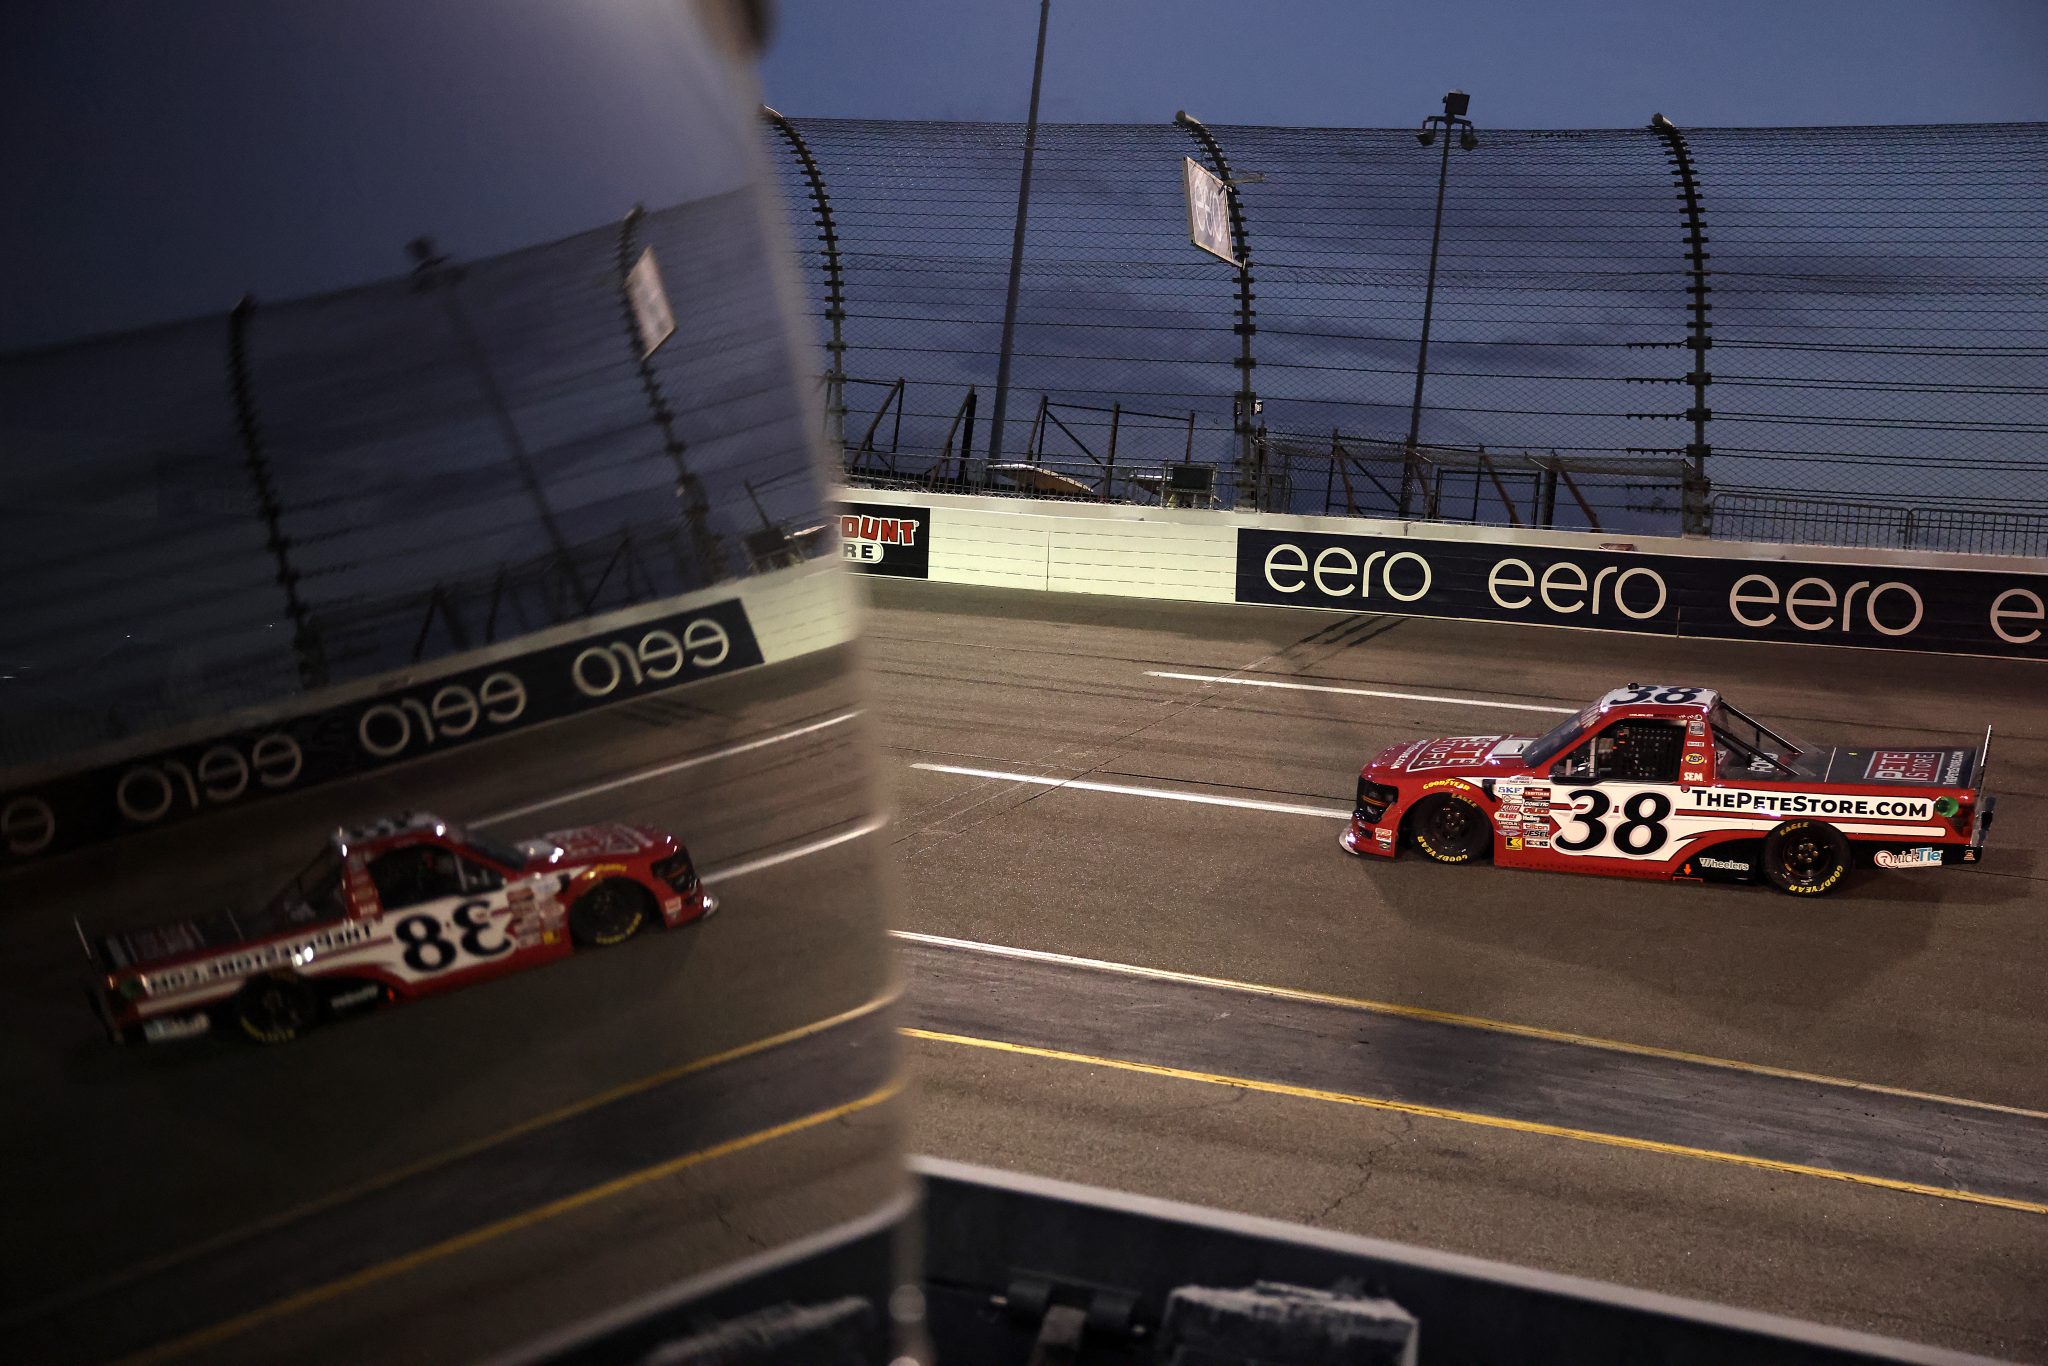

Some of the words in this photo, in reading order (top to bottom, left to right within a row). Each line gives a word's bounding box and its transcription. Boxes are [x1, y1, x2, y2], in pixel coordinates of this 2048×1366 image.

[1265, 543, 1431, 602] eero
[1488, 558, 1667, 619] eero
[1729, 574, 1924, 636] eero
[1610, 686, 1702, 704] 38
[1684, 772, 1703, 781] SEM
[1874, 753, 1930, 781] PETE
[1906, 753, 1935, 778] STORE
[1423, 778, 1470, 790] GOODYEAR
[1555, 790, 1671, 855] 38
[1780, 822, 1808, 836] EAGLE
[1699, 857, 1750, 871] Wheelers
[1789, 865, 1843, 893] GOODYEAR
